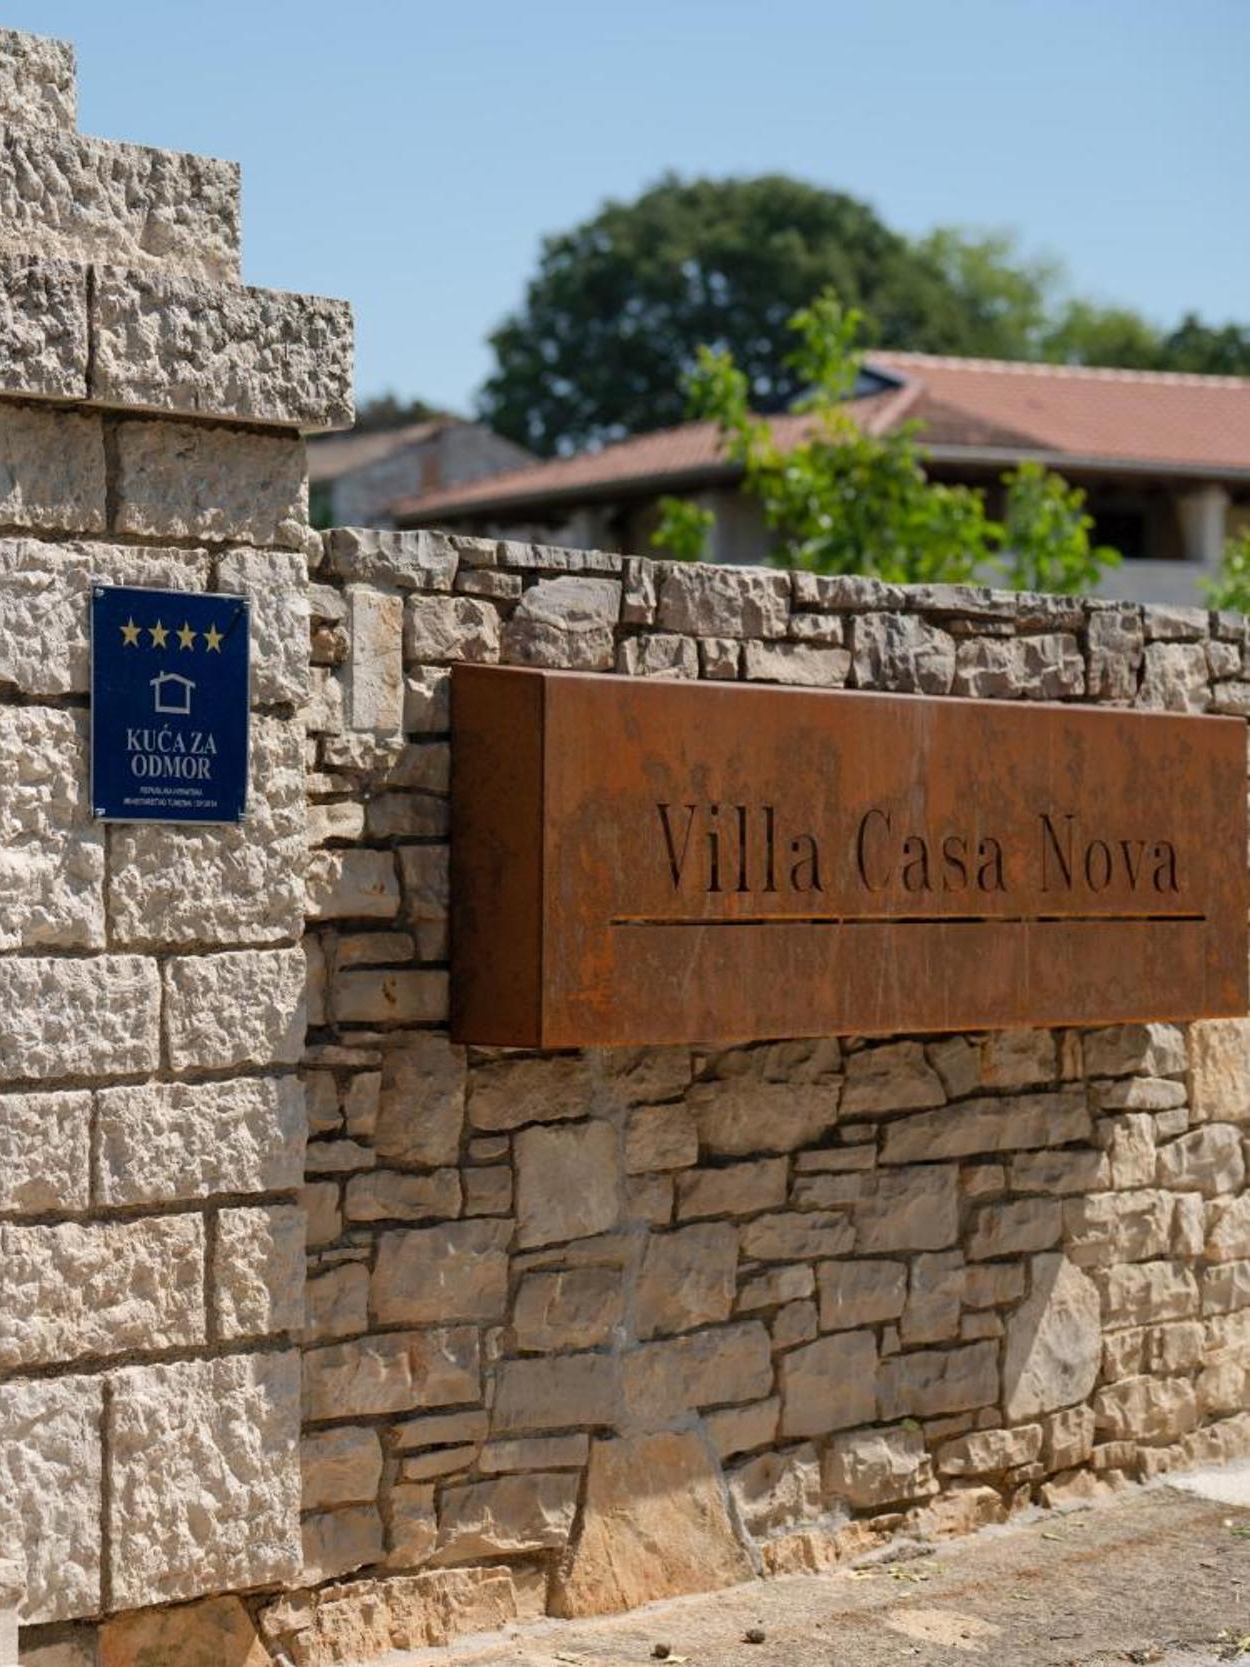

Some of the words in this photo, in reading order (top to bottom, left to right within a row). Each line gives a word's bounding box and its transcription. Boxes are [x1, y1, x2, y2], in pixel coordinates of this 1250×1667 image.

[127, 724, 186, 753] KUĆA
[190, 732, 217, 754] ZA
[131, 754, 211, 779] ODMOR
[656, 803, 823, 893] Villa
[855, 808, 1008, 893] Casa
[1039, 812, 1181, 893] Nova
